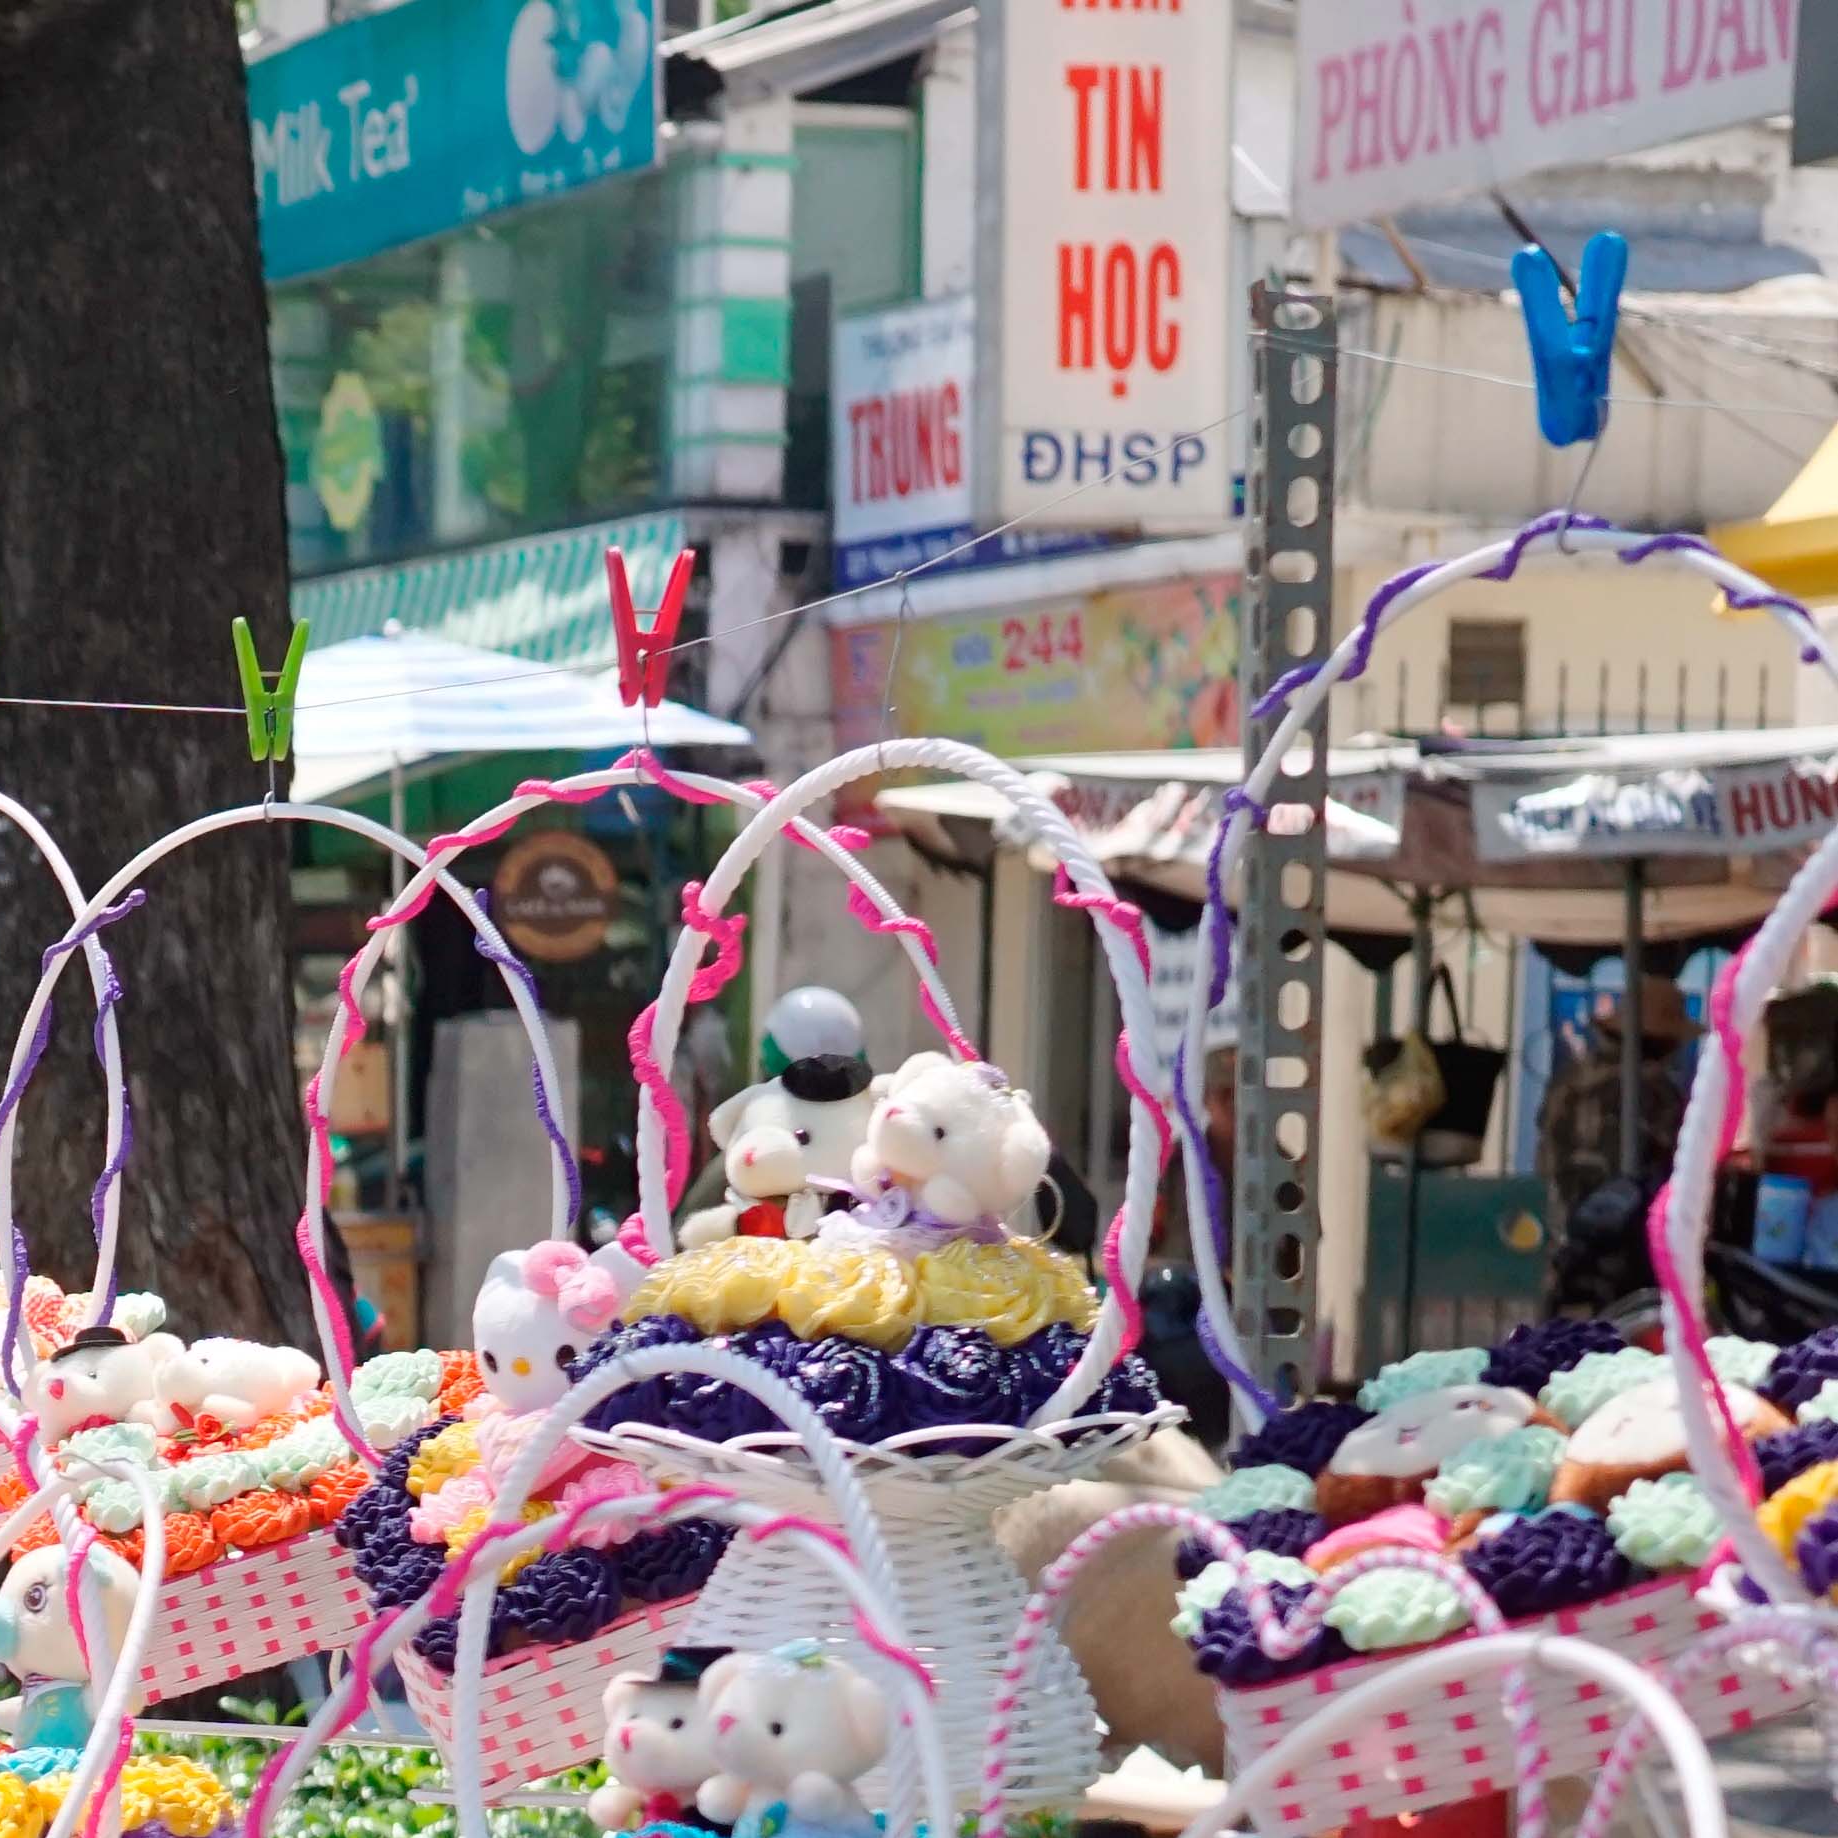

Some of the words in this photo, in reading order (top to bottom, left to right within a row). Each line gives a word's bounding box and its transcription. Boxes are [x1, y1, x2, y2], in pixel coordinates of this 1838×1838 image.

[1530, 0, 1637, 127] GHI
[1065, 65, 1163, 192] TIN
[1058, 242, 1181, 400] HỌC
[849, 380, 963, 504] TRUNG
[1022, 431, 1206, 486] ĐHSP
[1001, 610, 1084, 672] 244
